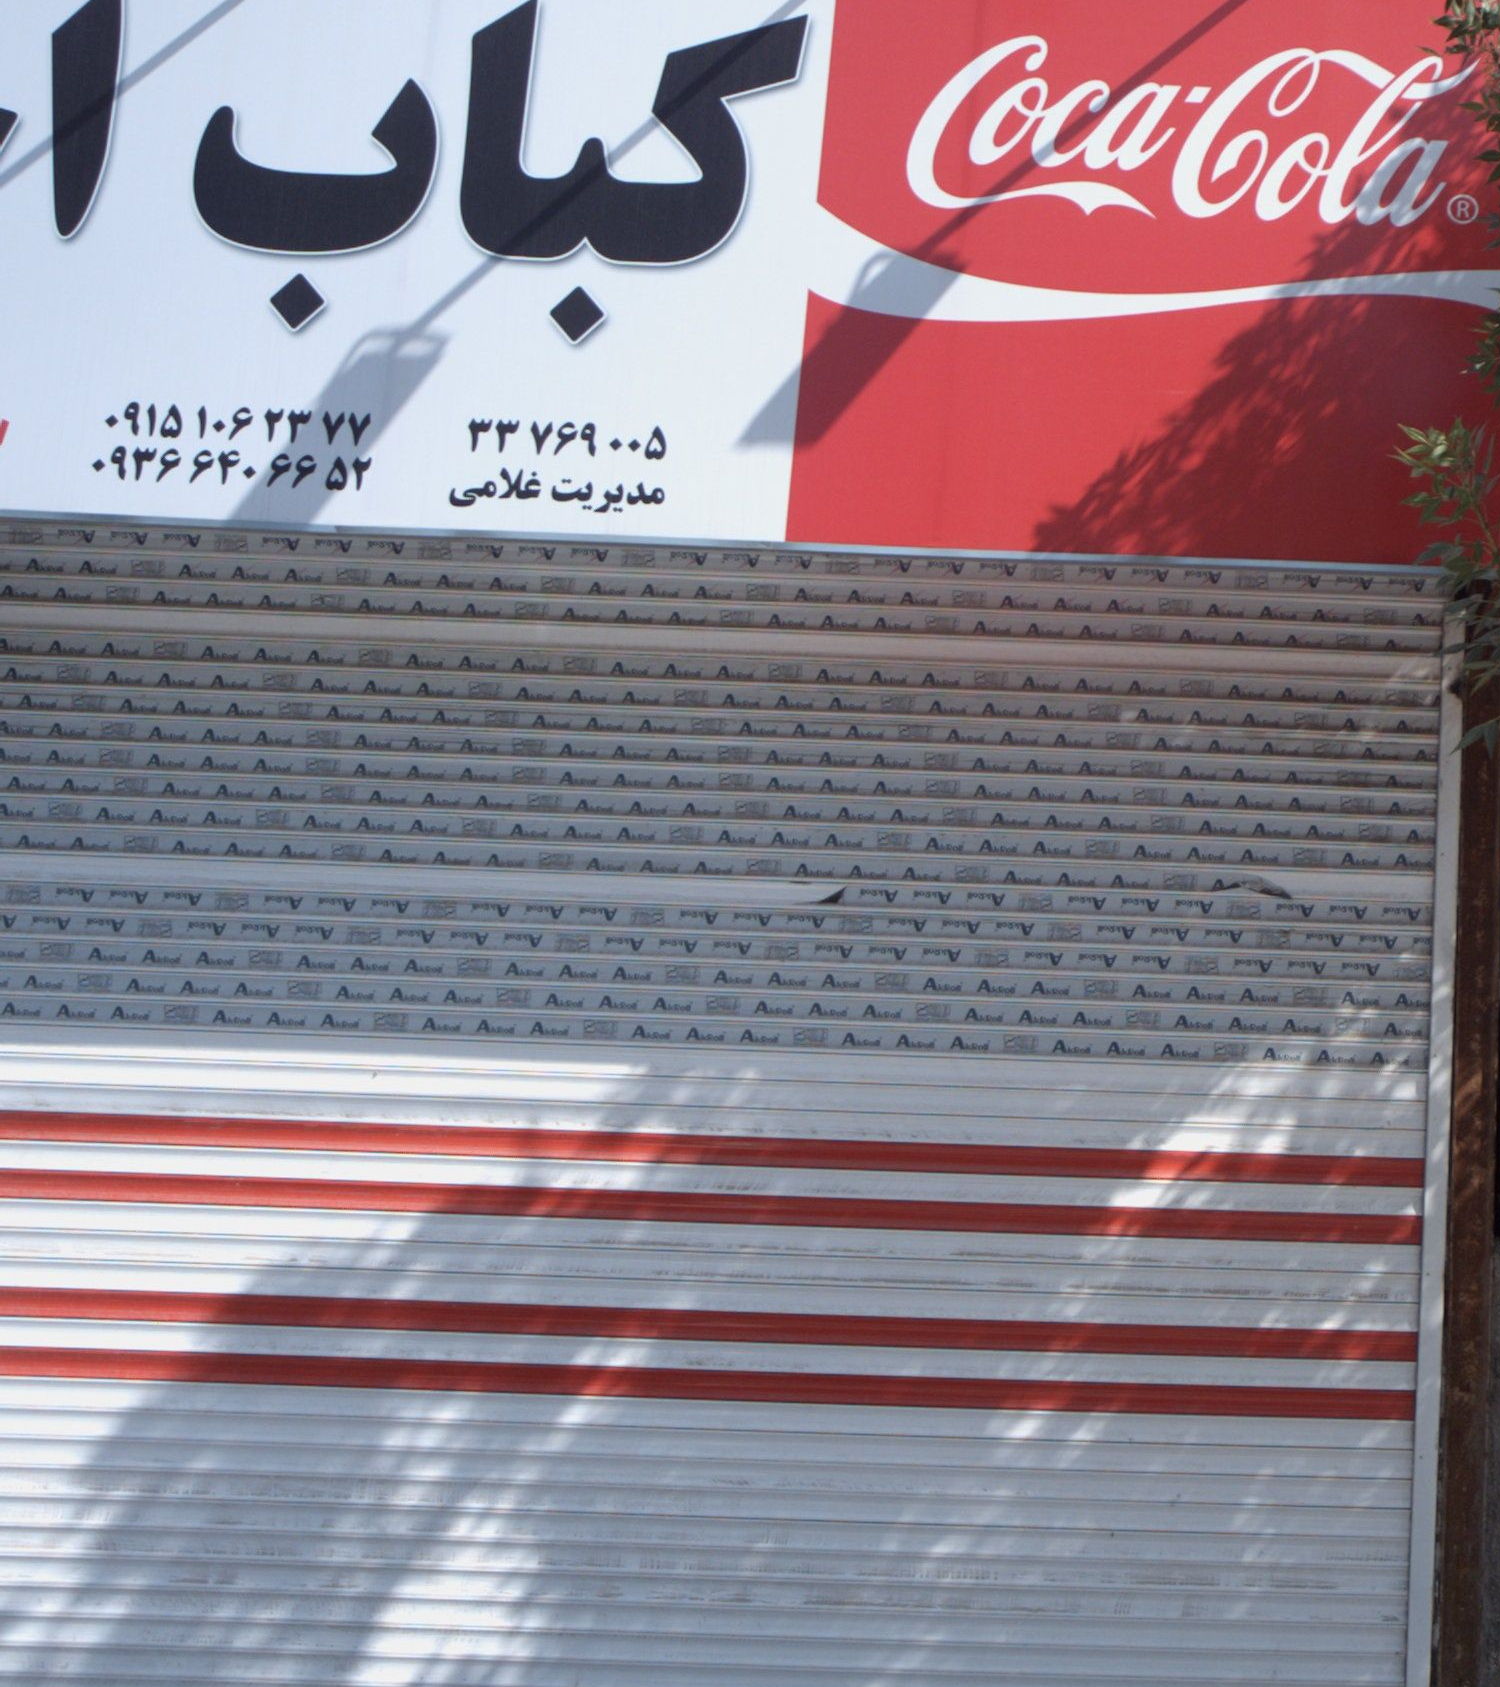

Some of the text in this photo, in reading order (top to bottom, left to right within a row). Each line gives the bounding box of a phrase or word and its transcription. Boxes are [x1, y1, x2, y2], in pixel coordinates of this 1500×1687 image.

[906, 36, 1481, 227] Coca-Cola
[193, 0, 809, 344] کباب
[105, 402, 371, 446] ۰۹۱۵ ۱۰۶ ۲۳ ۷۷
[468, 418, 666, 460] ۳۳ ۷۶۹ ۰۰۵
[92, 446, 372, 490] ۰۹۳۶ ۶۴۰ ۶۶ ۵۲
[449, 467, 665, 513] مدیریت غلامی
